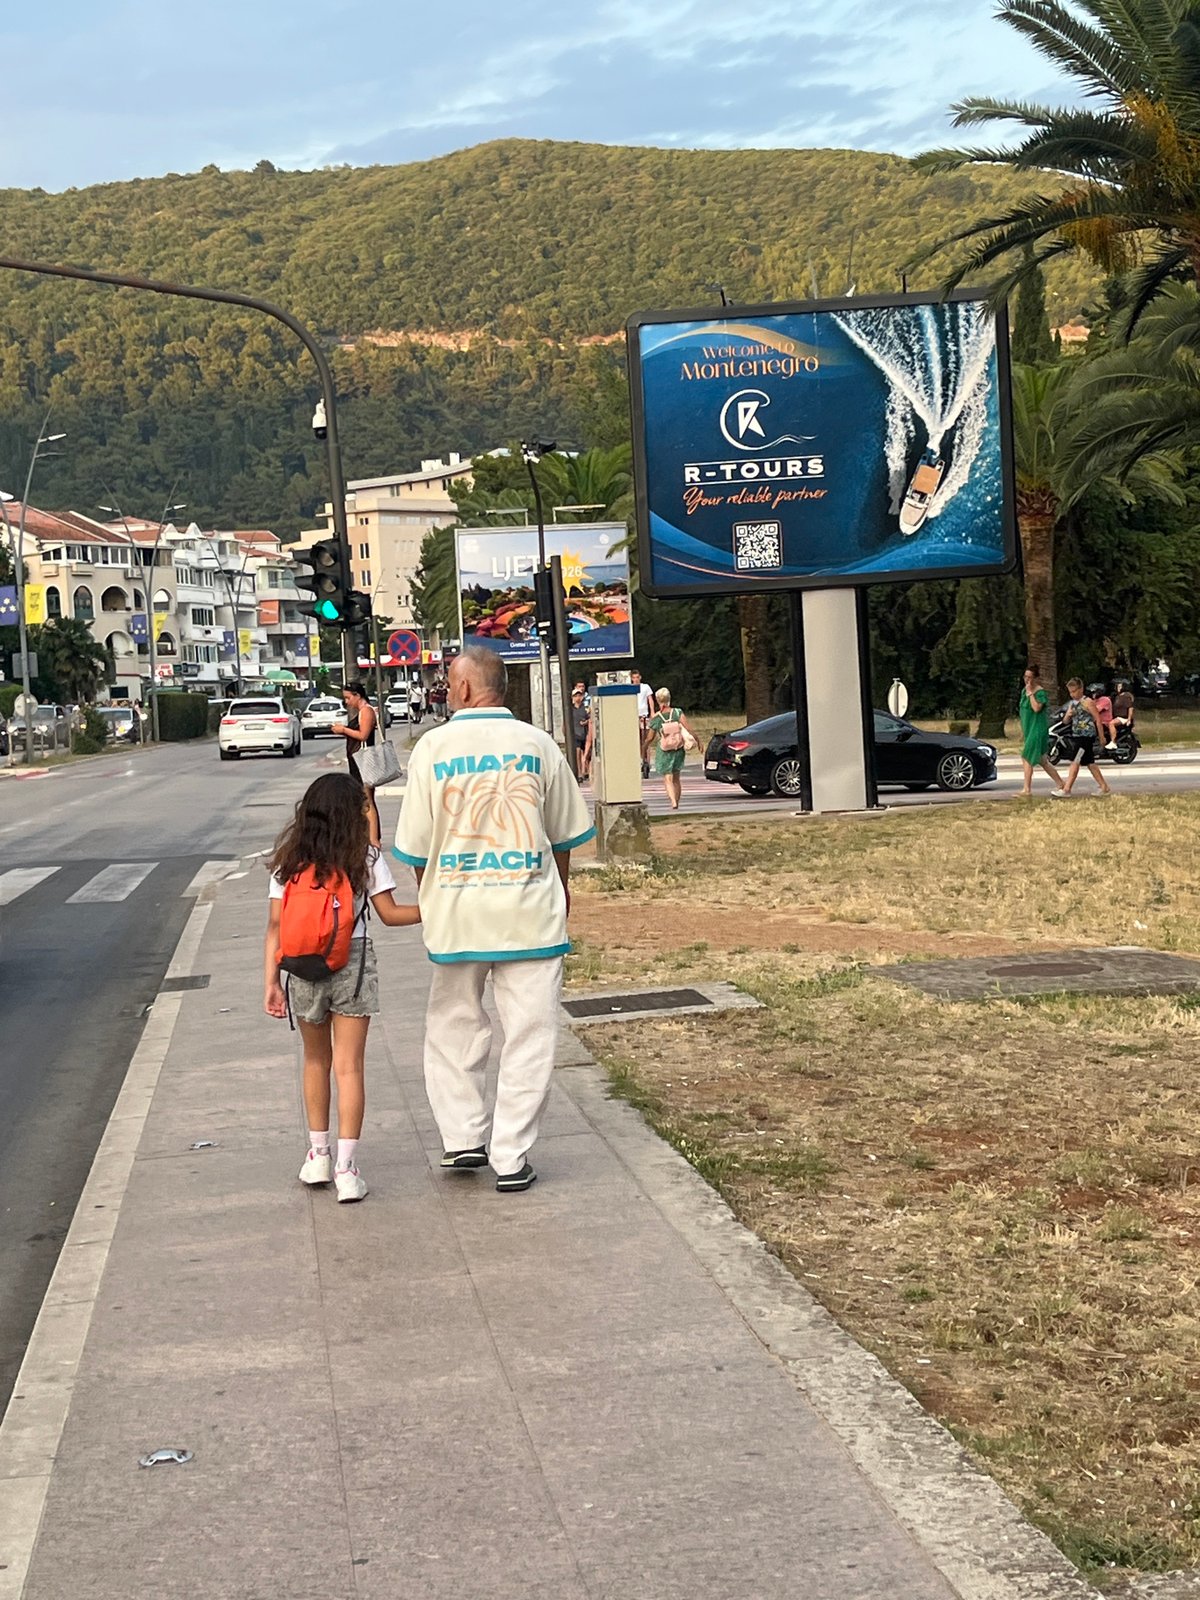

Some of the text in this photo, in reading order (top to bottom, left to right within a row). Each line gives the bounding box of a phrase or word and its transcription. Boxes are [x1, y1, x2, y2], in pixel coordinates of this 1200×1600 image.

[702, 344, 774, 359] Welcome
[680, 356, 819, 380] Montenegro
[684, 458, 824, 483] R-TOURS
[682, 485, 828, 515] Your reliable partner
[491, 553, 552, 582] LJET
[433, 753, 541, 782] MIAMI
